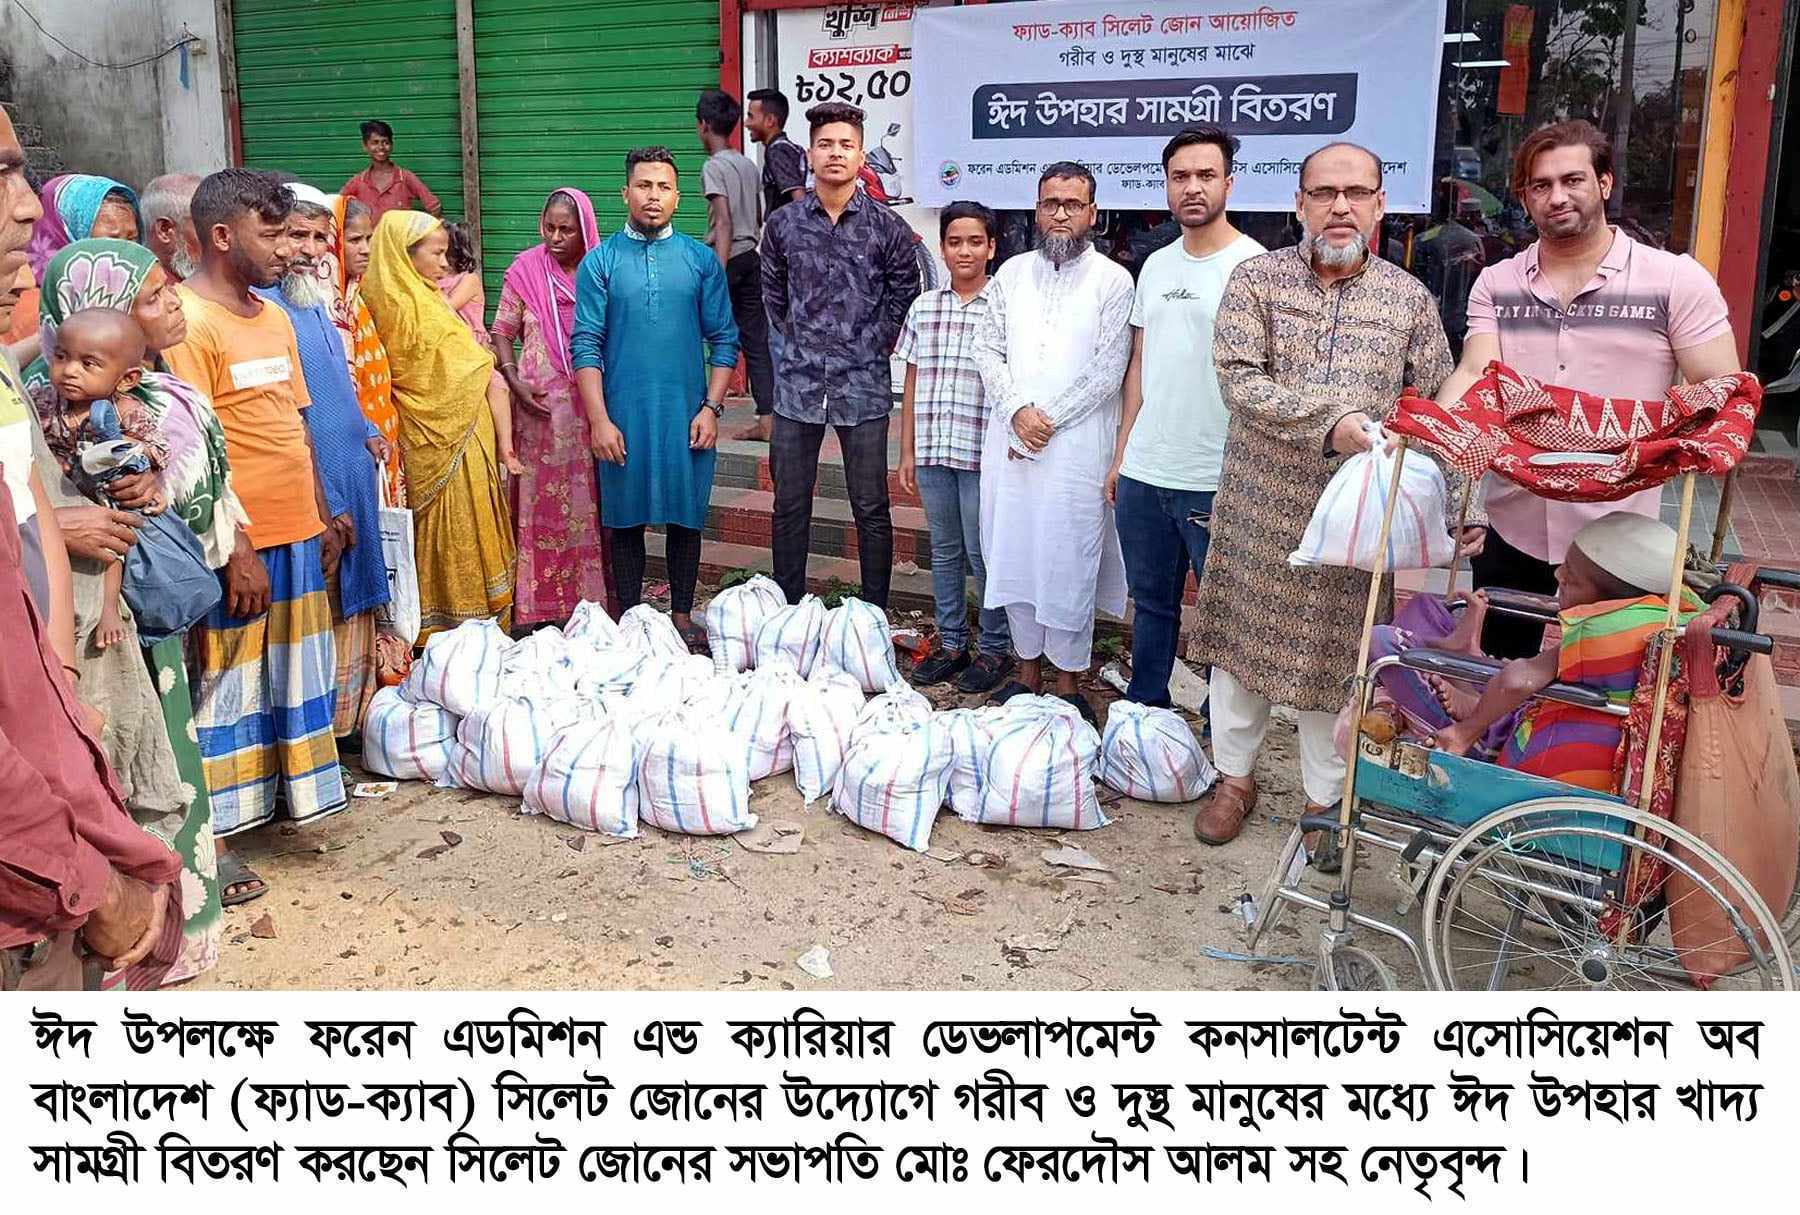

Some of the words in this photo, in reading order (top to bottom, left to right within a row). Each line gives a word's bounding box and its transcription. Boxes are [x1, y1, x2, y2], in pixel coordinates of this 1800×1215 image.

[1012, 20, 1095, 41] ফ্যাড-ক্যাব
[1103, 14, 1153, 37] সিলেট
[1161, 16, 1201, 34] জোন
[1209, 7, 1298, 31] আয়োজিত
[812, 47, 894, 65] ক্যাশব্যাক
[1059, 45, 1095, 67] গরীব
[1102, 53, 1114, 65] ও
[1121, 49, 1145, 69] দুস্থ
[1151, 46, 1208, 67] মানুষের
[1215, 42, 1255, 61] মাঝে
[988, 93, 1028, 129] ঈদ
[1035, 91, 1129, 127] উপহার
[1136, 84, 1222, 124] সামগ্রী
[1230, 83, 1337, 122] বিতরণ
[996, 159, 1037, 175] এডমিশন
[1107, 162, 1163, 175] ডেভেলপমে
[1494, 305, 1520, 319] TAY
[1608, 305, 1656, 320] GAME
